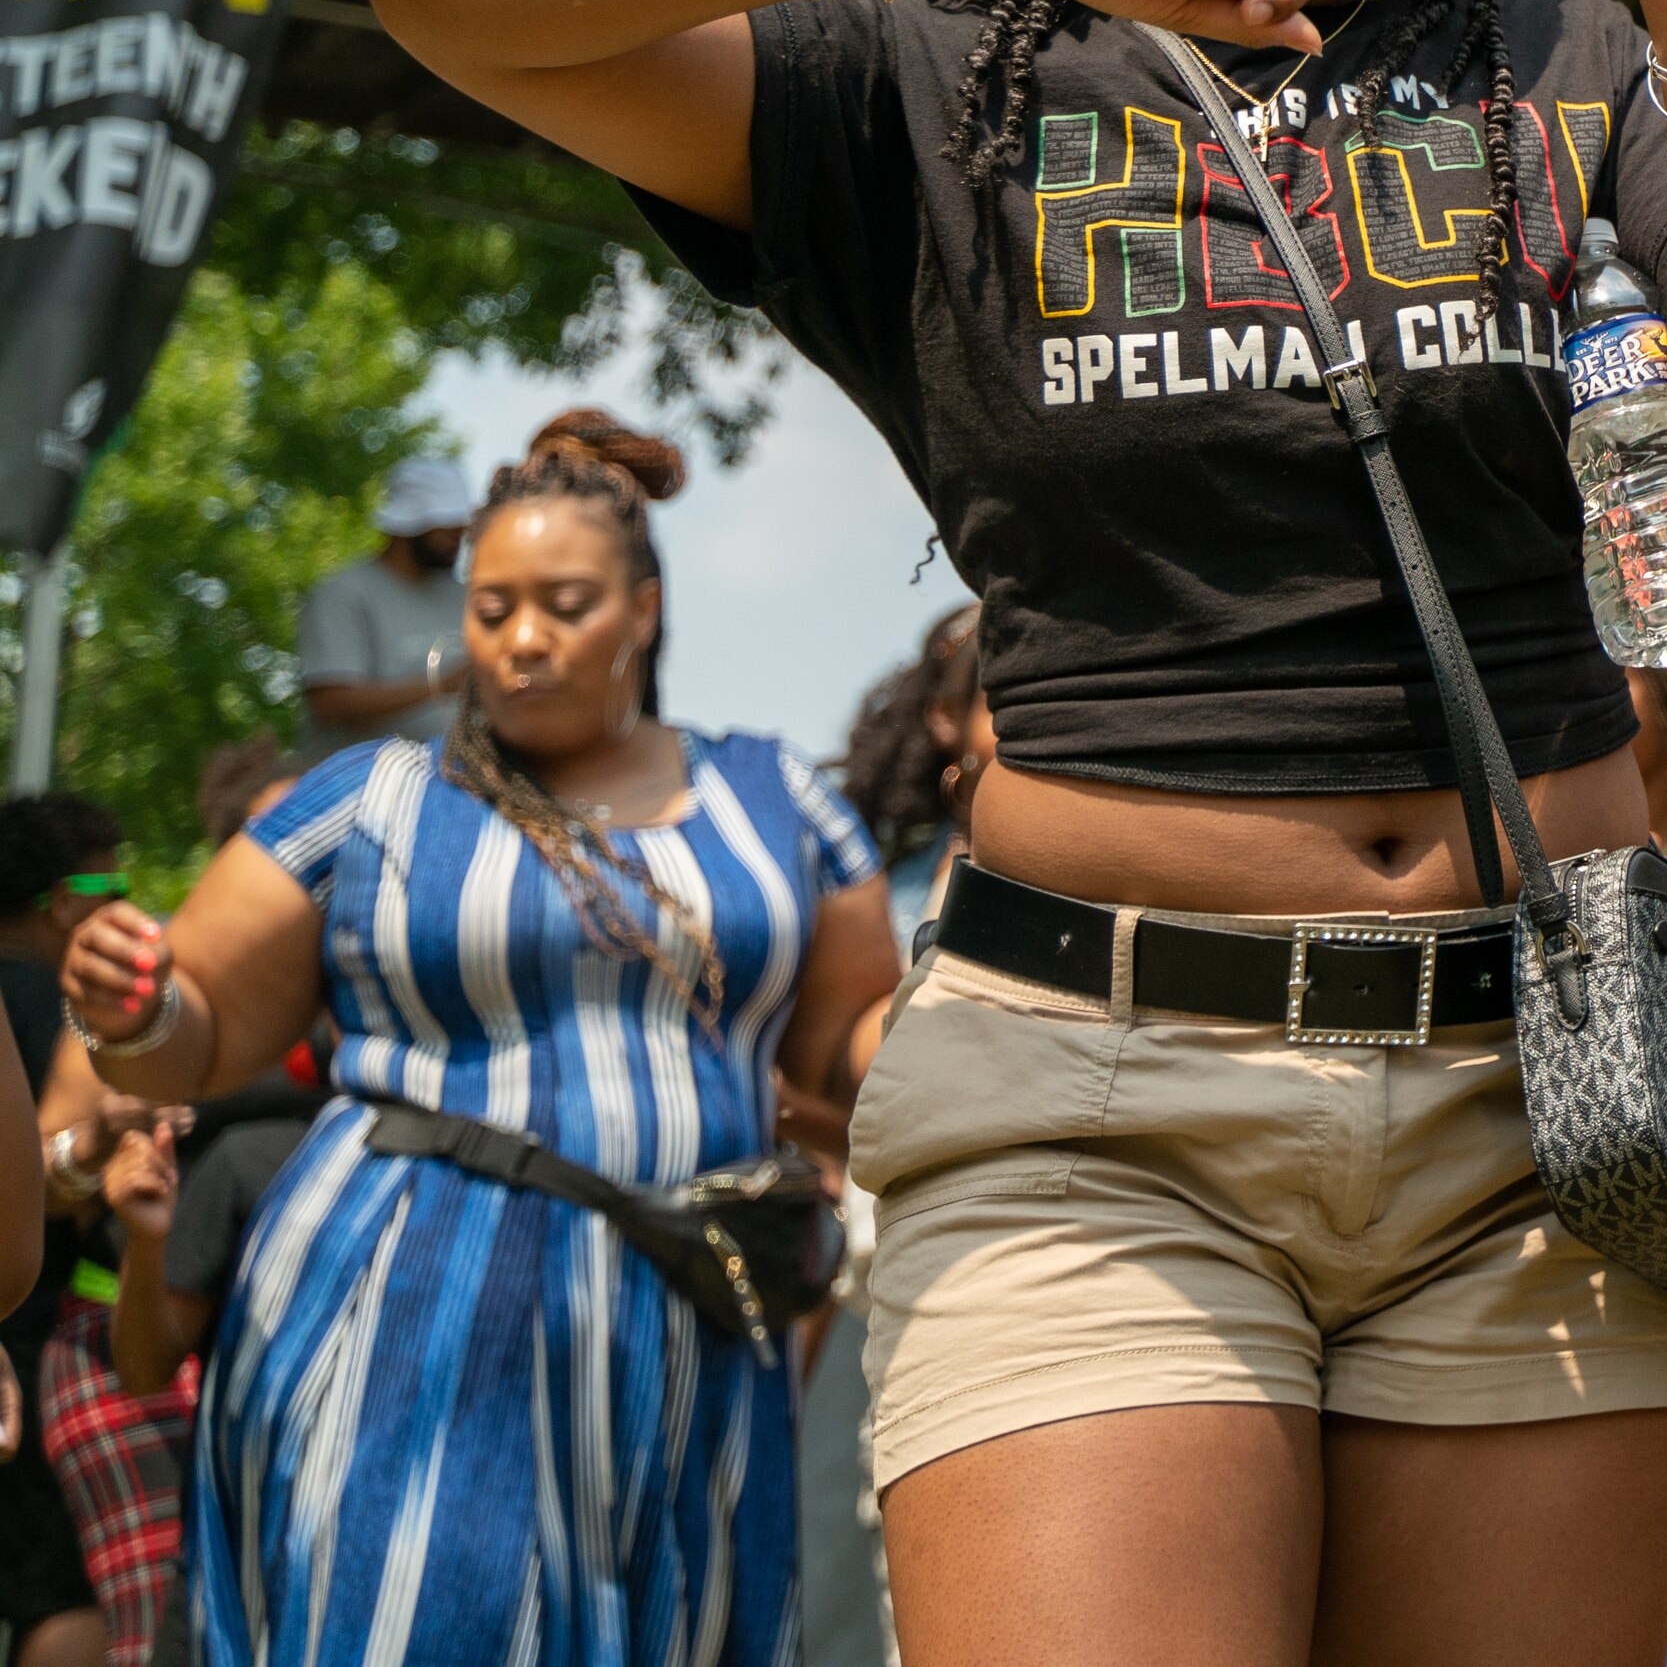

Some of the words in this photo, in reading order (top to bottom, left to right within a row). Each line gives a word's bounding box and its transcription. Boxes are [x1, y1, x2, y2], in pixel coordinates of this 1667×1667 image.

[1198, 88, 1307, 139] HIS
[1566, 336, 1646, 383] DEER
[1570, 358, 1655, 408] PARK
